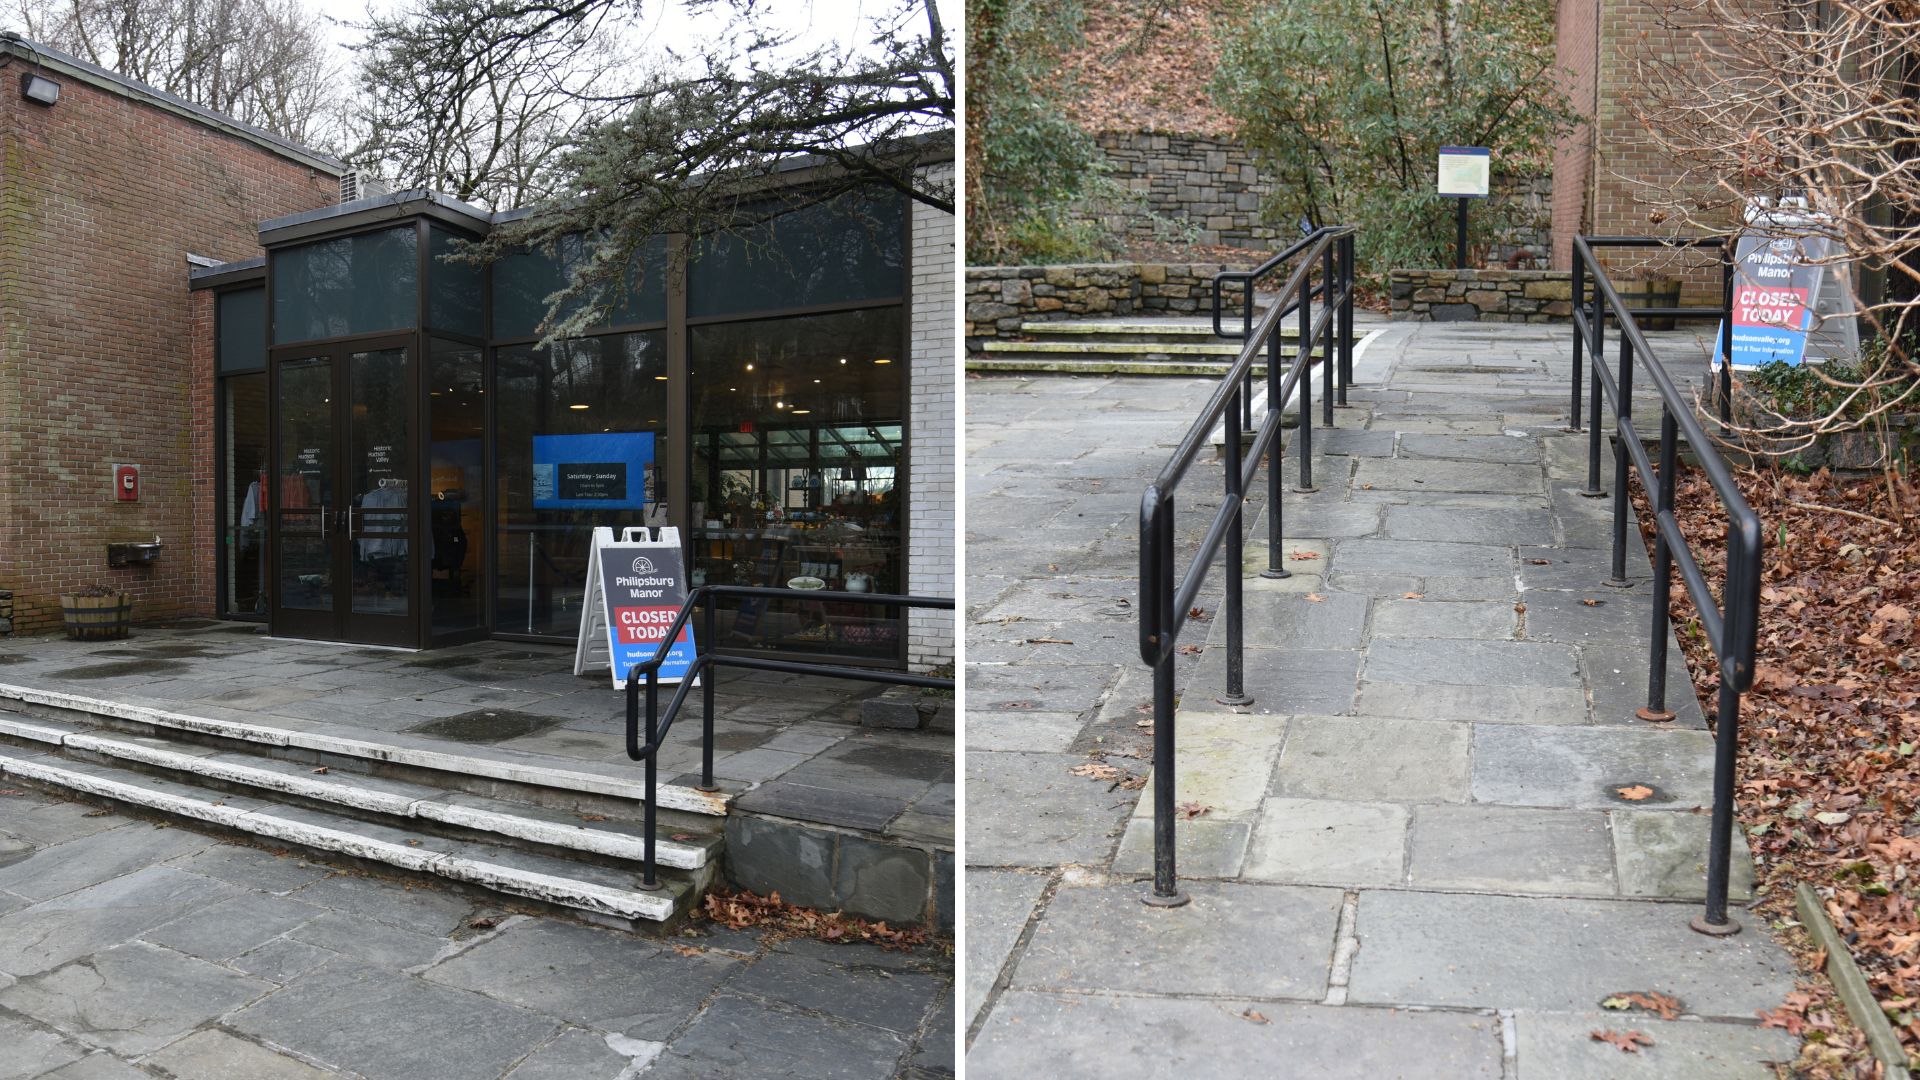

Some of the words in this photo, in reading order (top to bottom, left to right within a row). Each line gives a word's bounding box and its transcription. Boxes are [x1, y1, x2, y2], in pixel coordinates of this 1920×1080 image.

[1758, 266, 1794, 278] Manor
[1741, 291, 1800, 307] CLOSED
[1742, 308, 1793, 323] TODAY
[616, 577, 674, 587] Philipsburg
[630, 589, 663, 598] Manor
[621, 611, 677, 624] CLOSED
[627, 626, 671, 639] TODA
